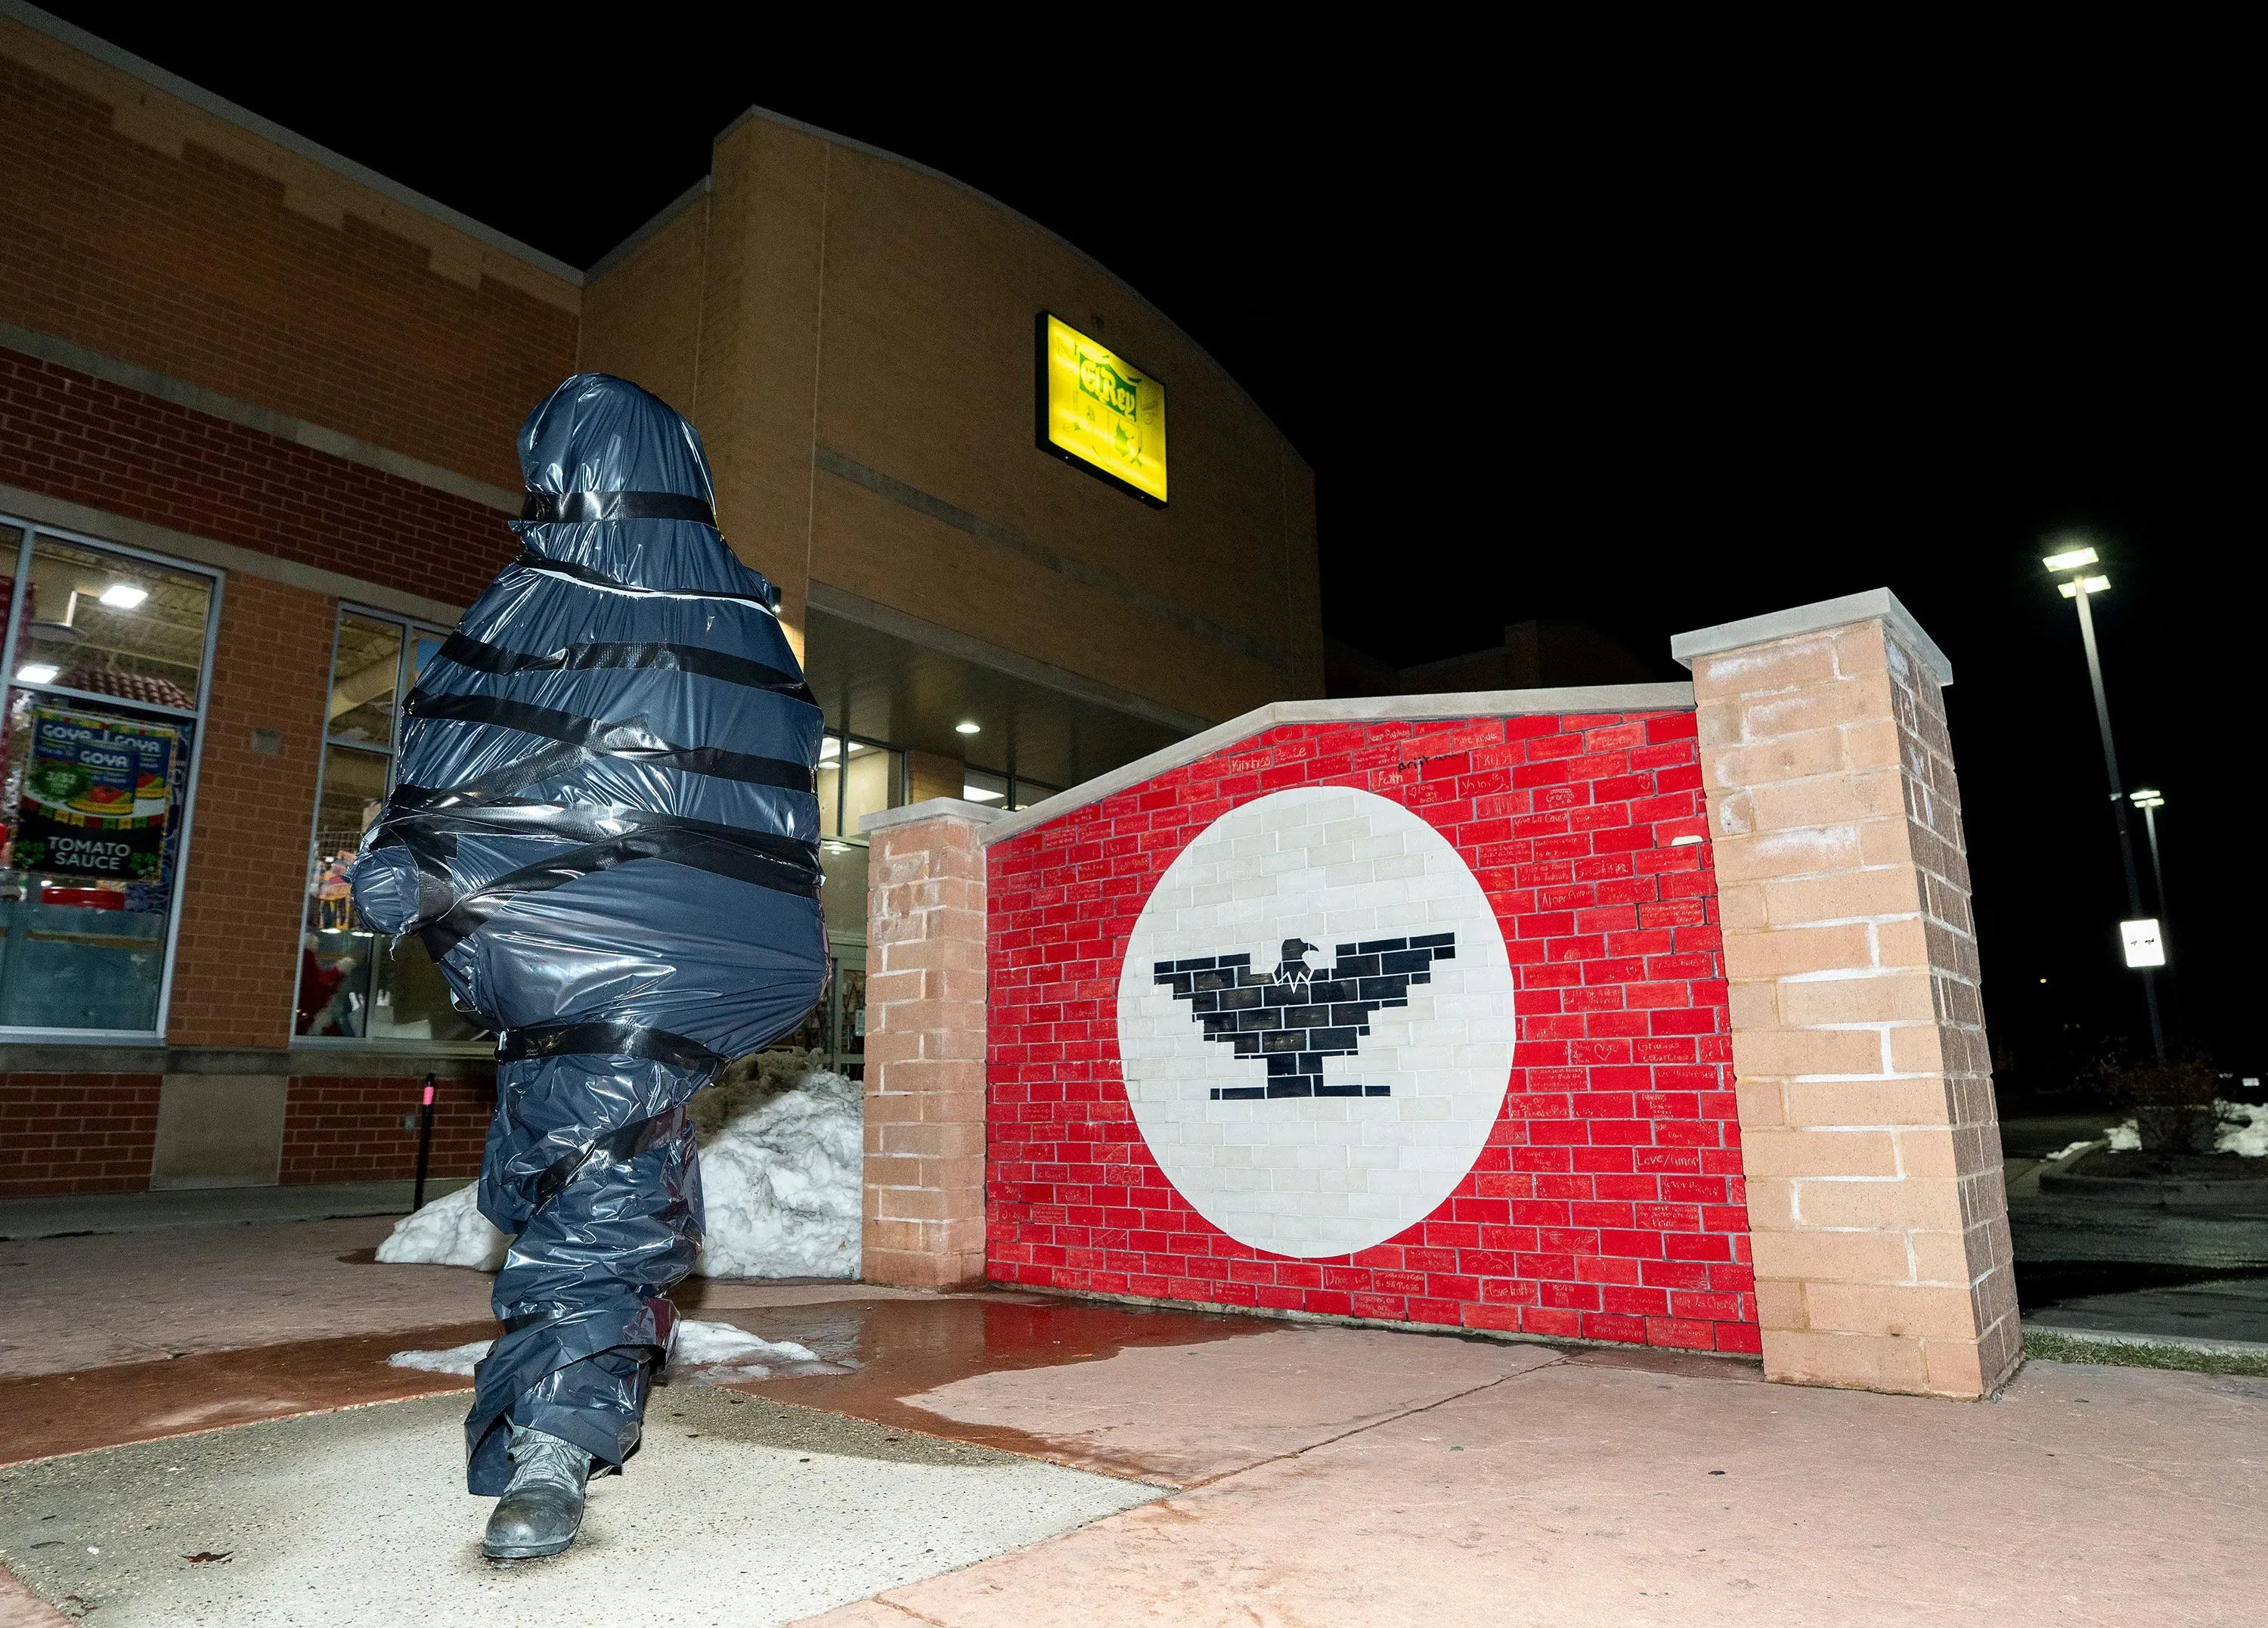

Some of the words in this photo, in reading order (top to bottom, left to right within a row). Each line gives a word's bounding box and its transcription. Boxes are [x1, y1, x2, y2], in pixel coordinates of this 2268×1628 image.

[42, 724, 92, 740] GOYA
[79, 750, 129, 767] GOYA
[48, 836, 131, 857] TOMATO
[54, 851, 121, 870] SAUCE
